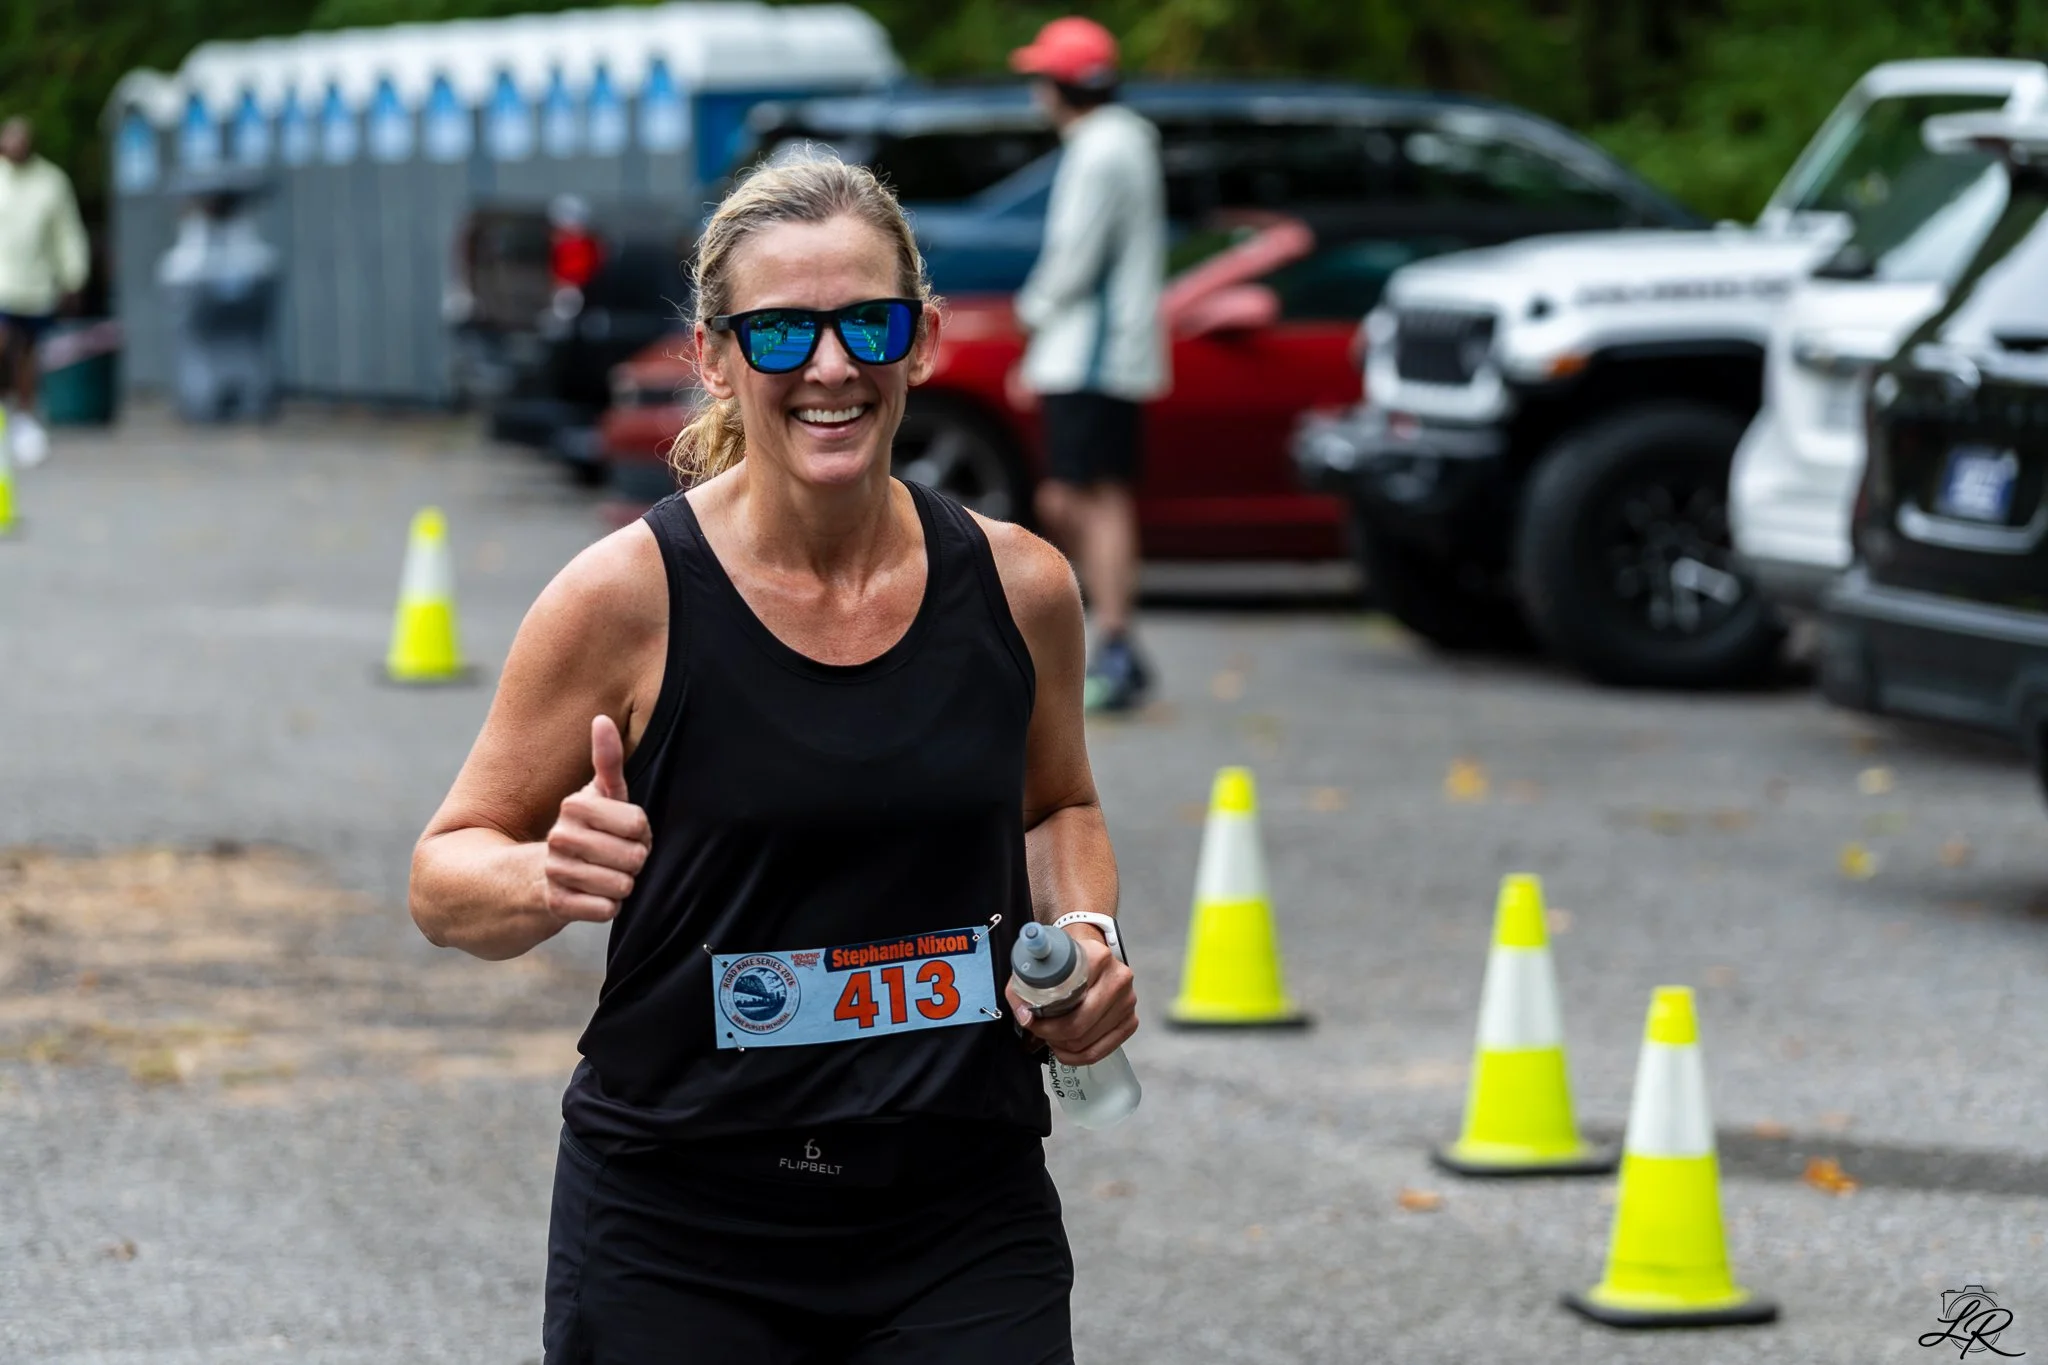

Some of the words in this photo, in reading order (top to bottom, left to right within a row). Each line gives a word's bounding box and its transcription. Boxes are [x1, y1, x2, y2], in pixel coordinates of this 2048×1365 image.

[832, 940, 914, 968] Stephanie
[917, 935, 969, 956] Nixon
[723, 969, 738, 988] ROAD
[737, 958, 756, 972] RACE
[757, 957, 782, 971] SERIES
[780, 968, 796, 986] 2026
[834, 959, 961, 1029] 413
[779, 1157, 843, 1175] FLIPBELT
